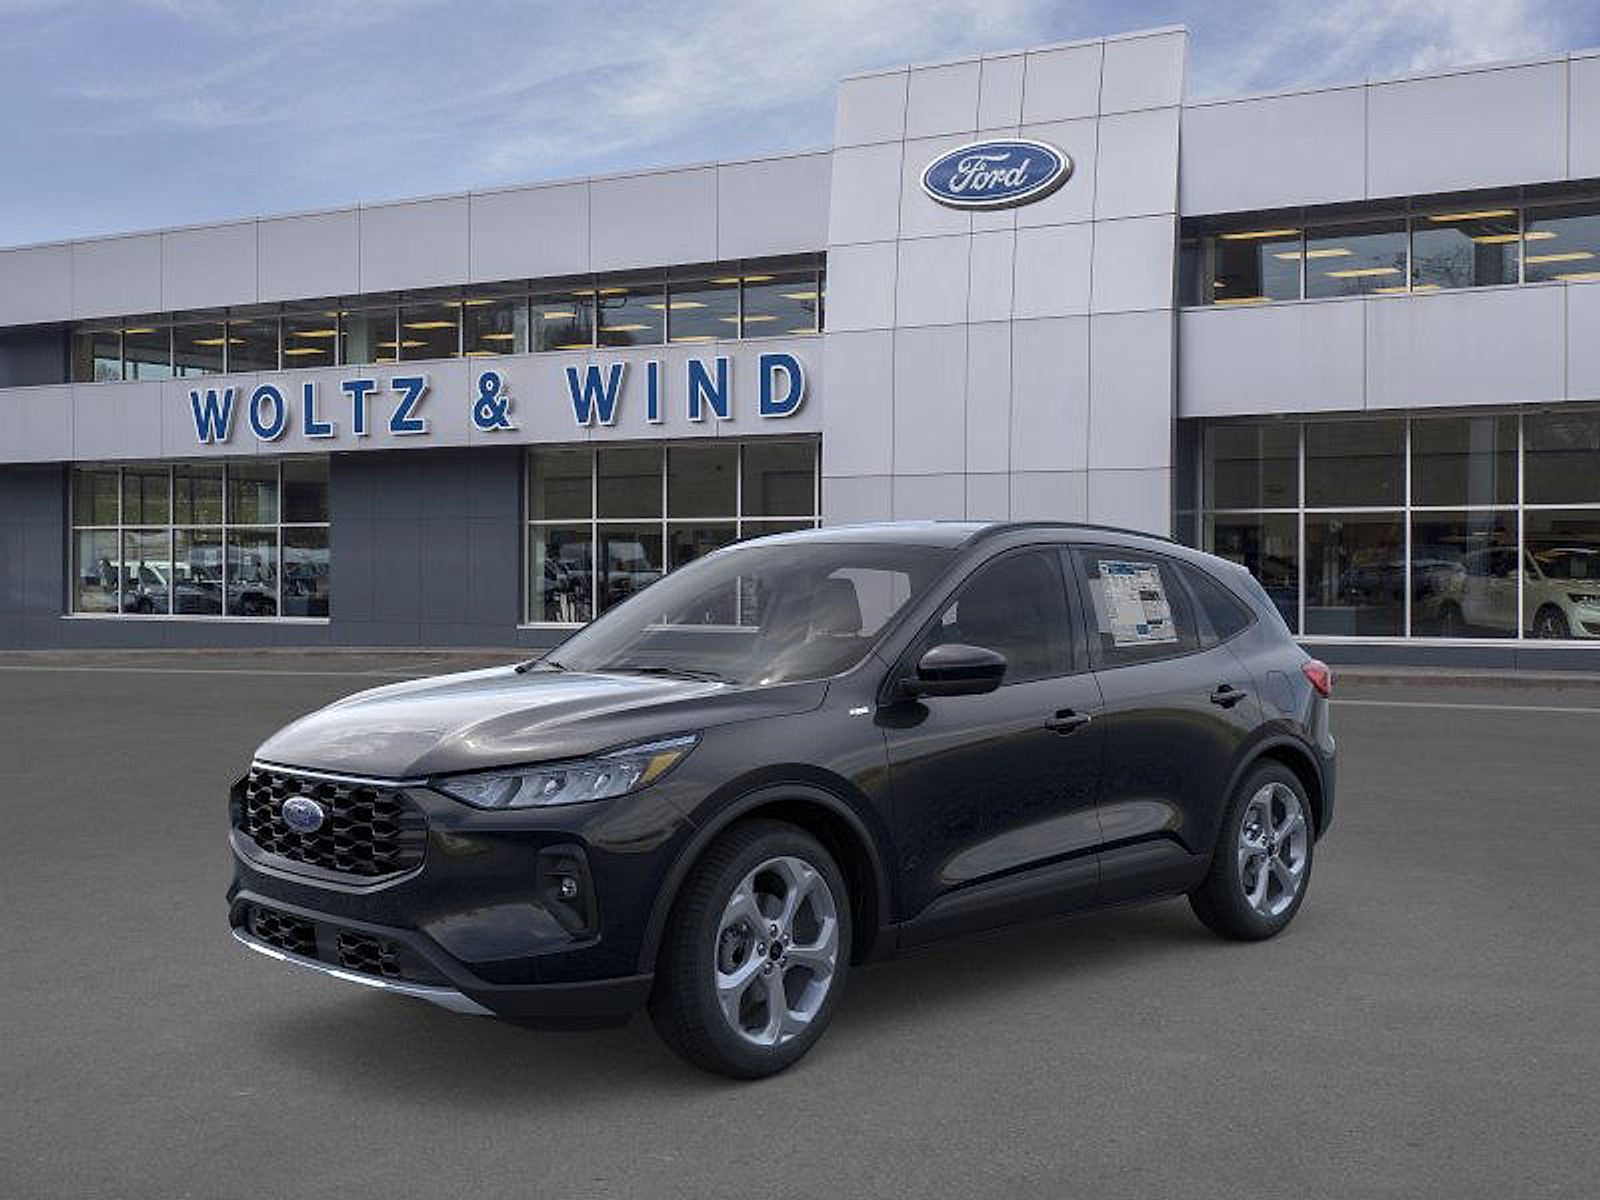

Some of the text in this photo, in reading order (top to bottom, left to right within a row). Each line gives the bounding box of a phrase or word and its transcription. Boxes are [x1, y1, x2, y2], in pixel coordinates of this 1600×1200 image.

[948, 152, 1031, 193] Ford
[189, 353, 806, 444] WOLTZ & WIND
